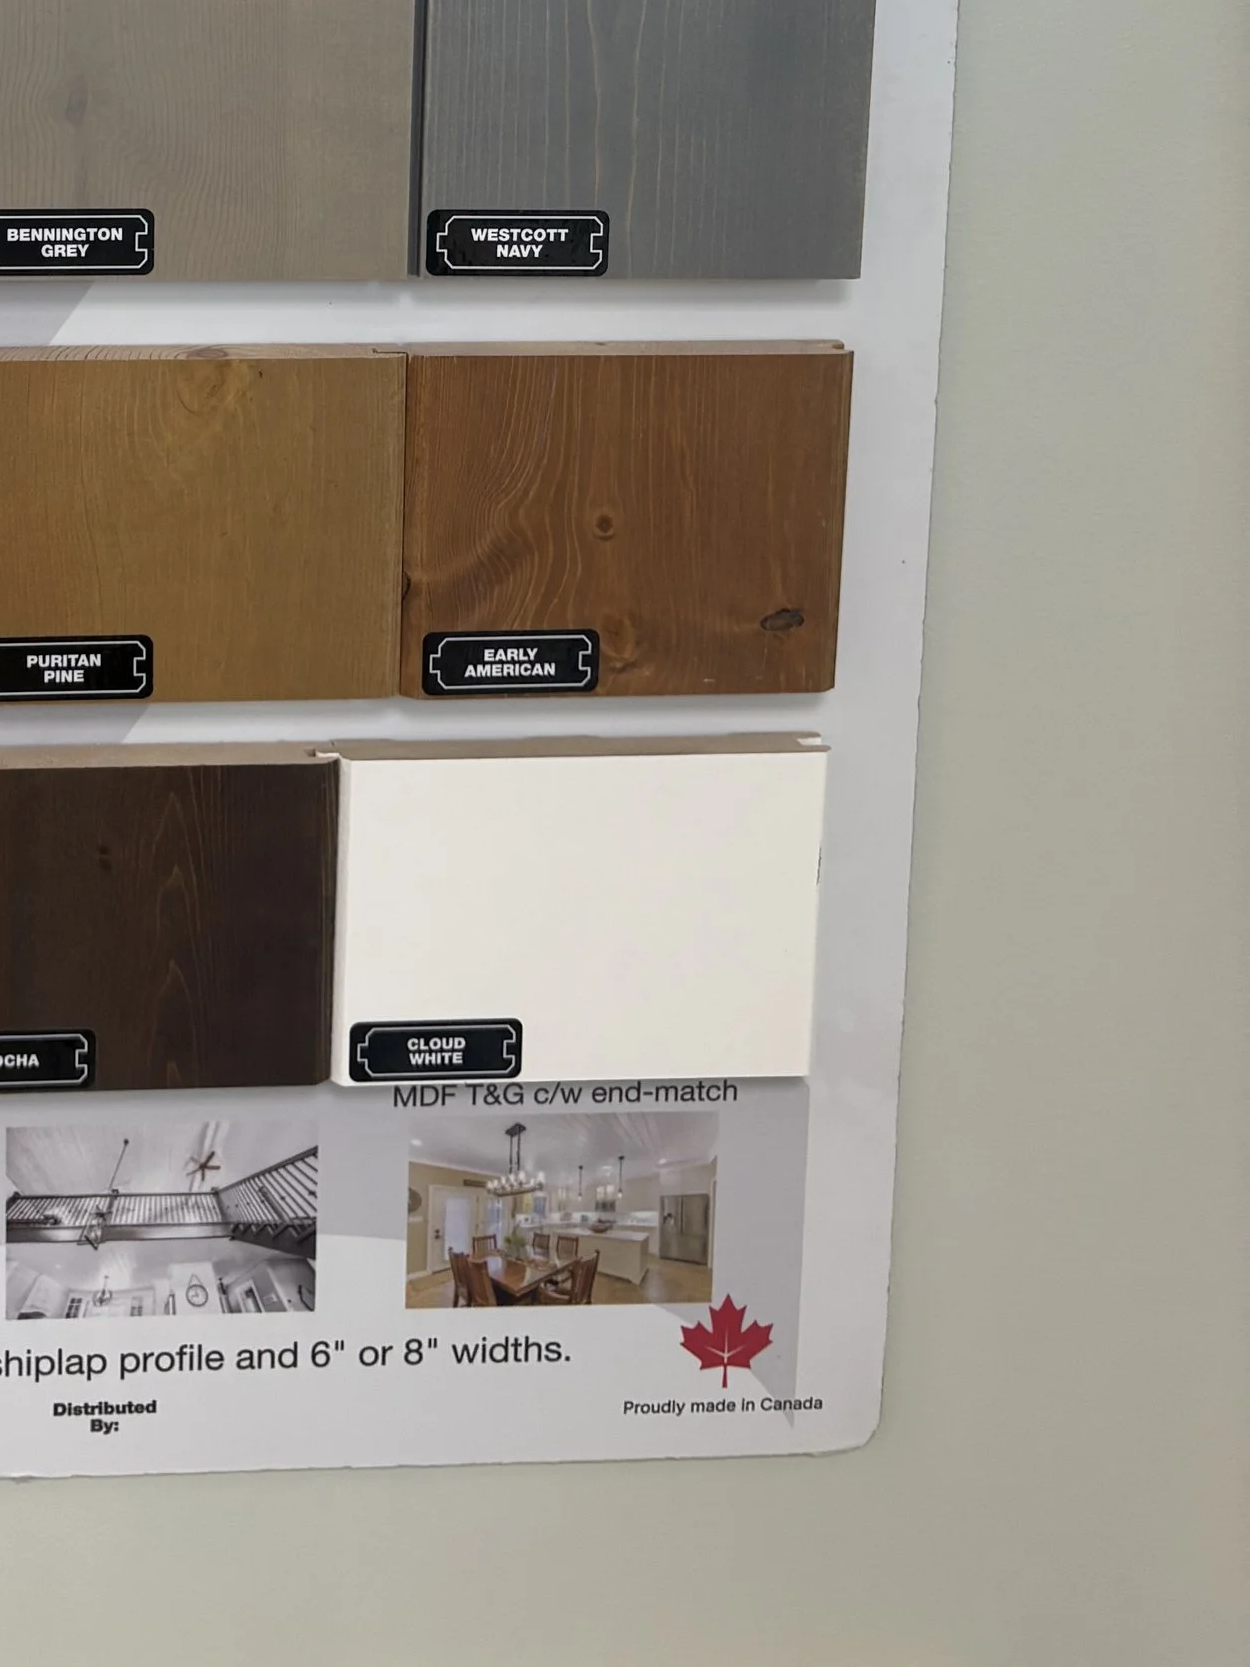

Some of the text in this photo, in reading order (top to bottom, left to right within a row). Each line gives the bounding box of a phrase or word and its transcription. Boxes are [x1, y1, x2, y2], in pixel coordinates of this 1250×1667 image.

[6, 227, 123, 242] BENNINGTON
[470, 228, 569, 242] WESTCOTT
[40, 244, 90, 258] GREY
[496, 244, 543, 258] NAVY
[26, 653, 102, 669] PURITAN
[483, 647, 539, 662] EARLY
[43, 669, 85, 684] PINE
[463, 662, 556, 678] AMERICAN
[407, 1037, 466, 1051] CLOUD
[408, 1051, 464, 1066] WHITE
[393, 1079, 738, 1108] MDF T&G c/w end-match
[119, 1344, 225, 1380] profile
[235, 1341, 299, 1370] and
[310, 1340, 345, 1369] 6"
[358, 1342, 394, 1368] or
[403, 1337, 438, 1366] 8"
[451, 1335, 571, 1365] widths.
[52, 1400, 157, 1418] Distributed
[623, 1396, 824, 1417] Proudly made in Canada
[89, 1418, 120, 1434] By:
